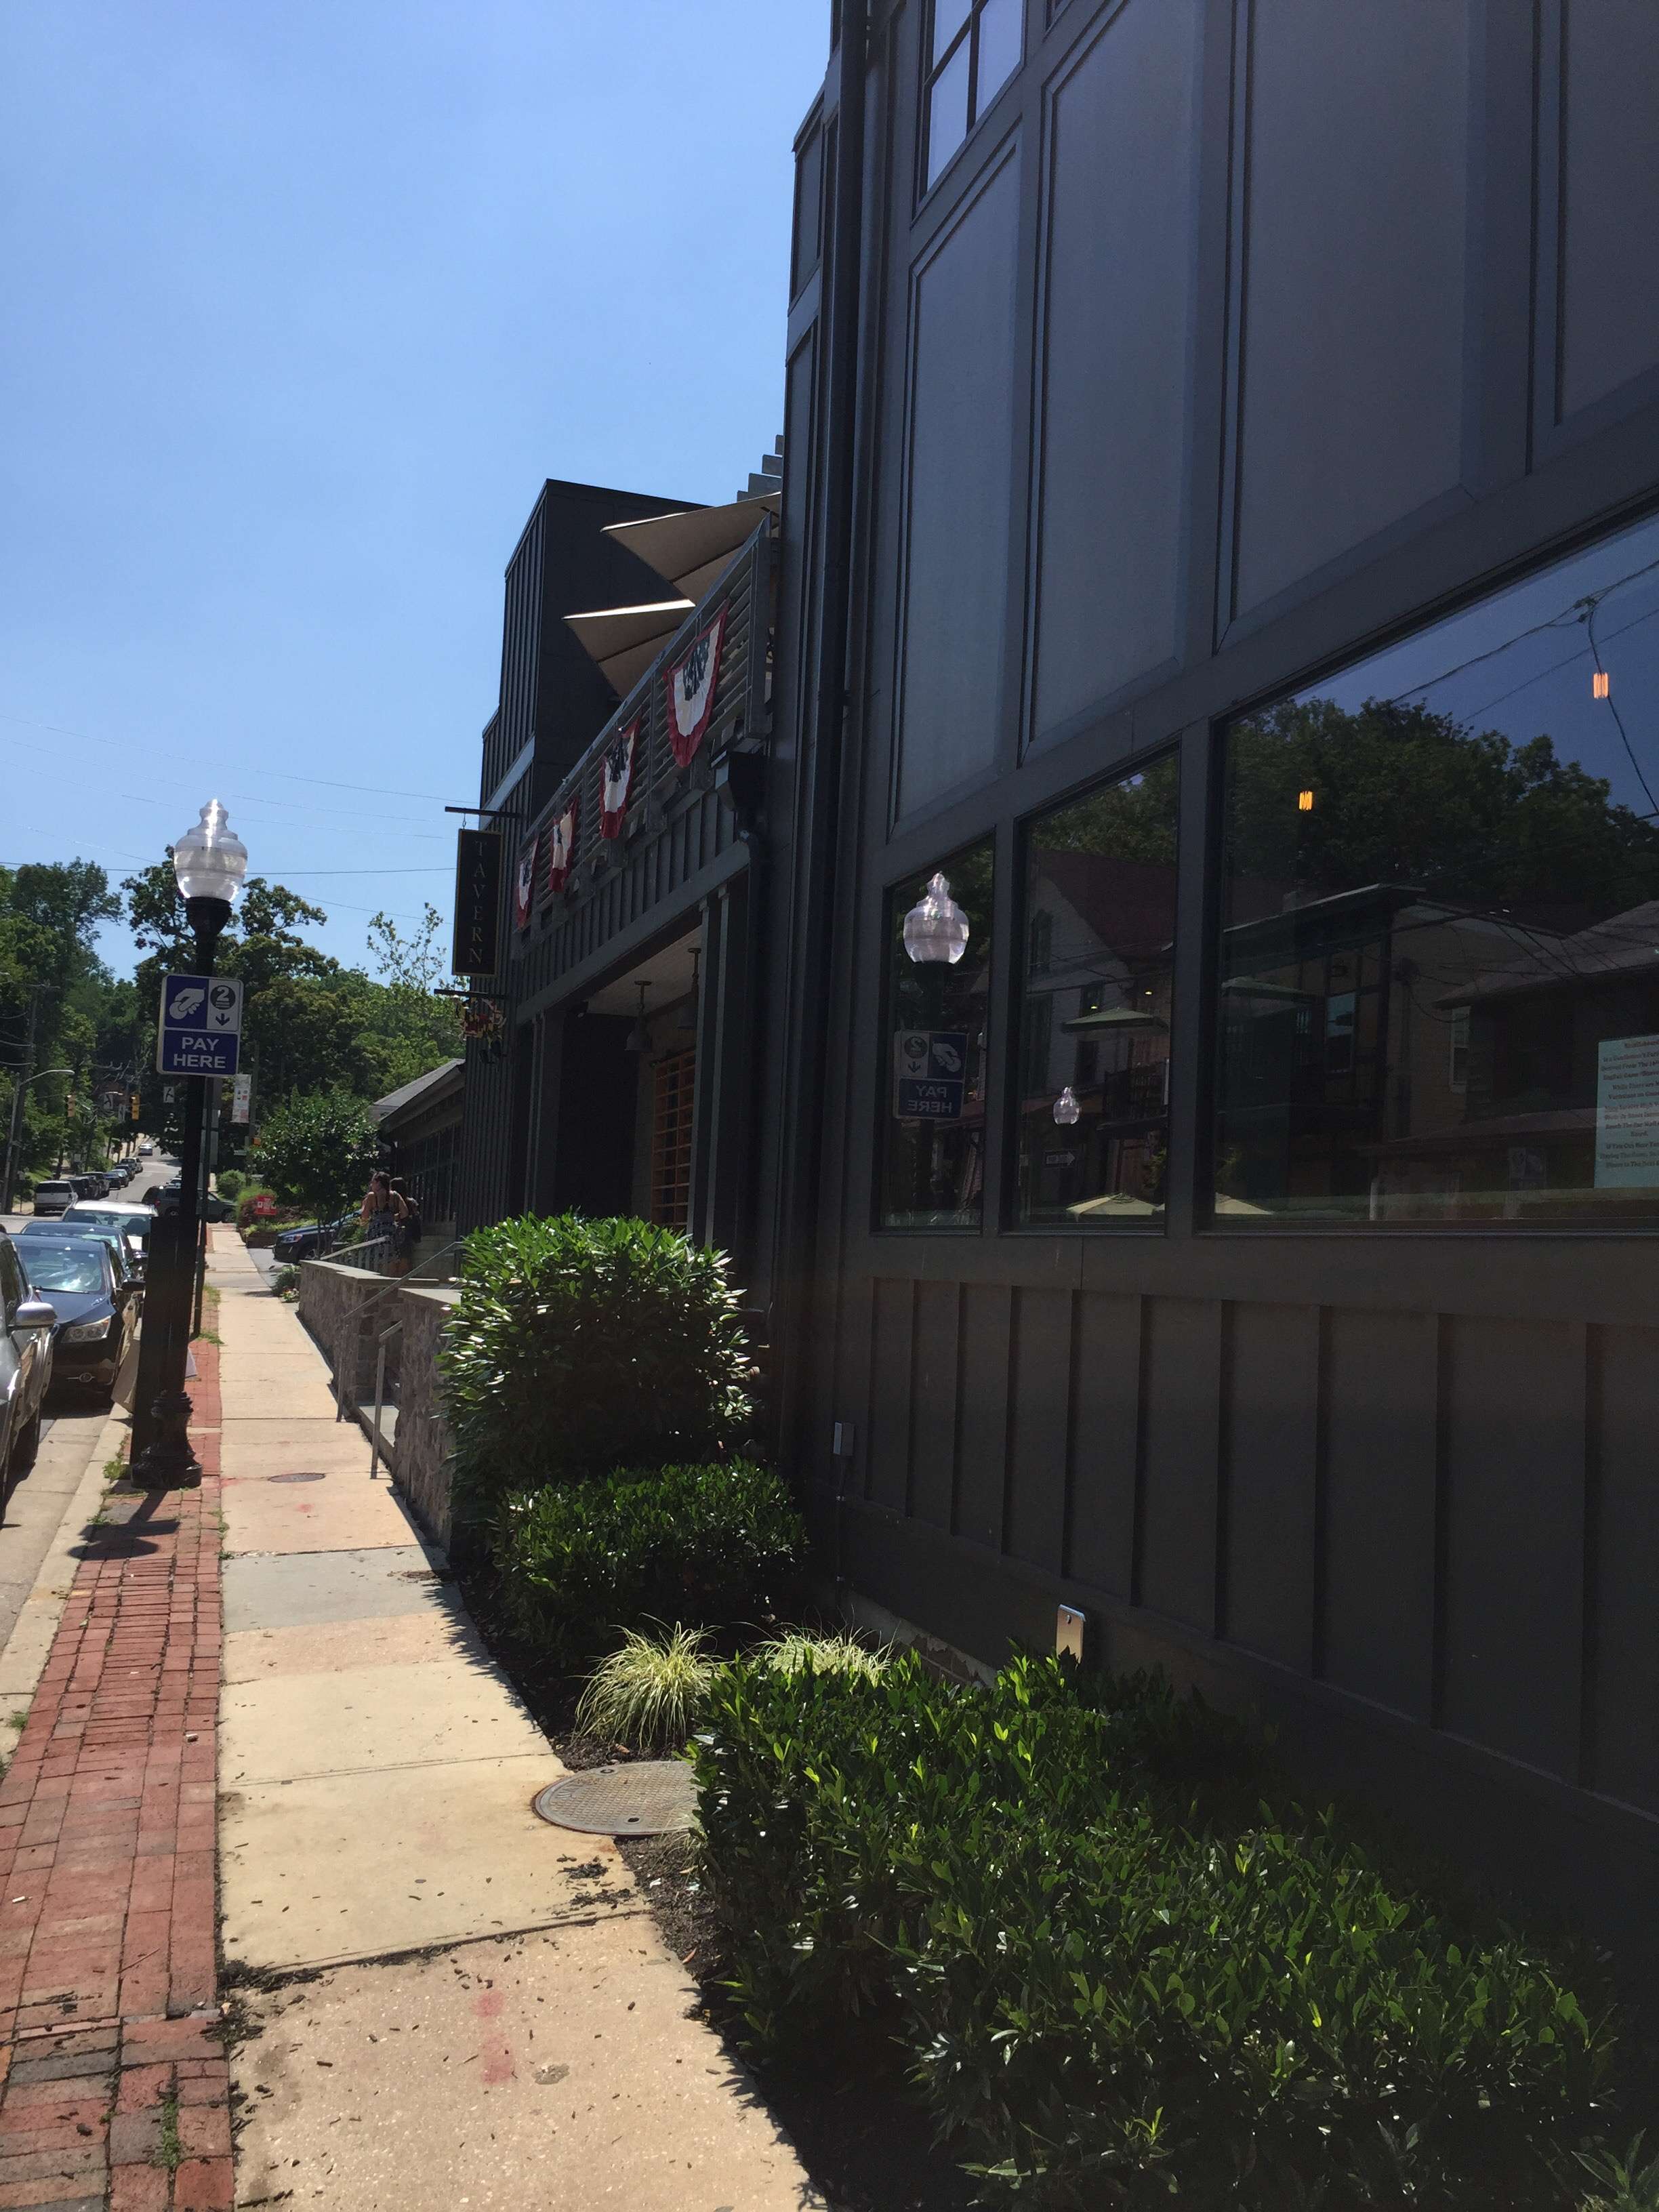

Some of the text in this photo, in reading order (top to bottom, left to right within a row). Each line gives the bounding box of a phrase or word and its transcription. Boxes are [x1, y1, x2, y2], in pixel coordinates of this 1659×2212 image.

[468, 840, 488, 965] TAVERN
[217, 985, 230, 1002] 2
[182, 1036, 220, 1052] PAY
[173, 1053, 226, 1069] HERE
